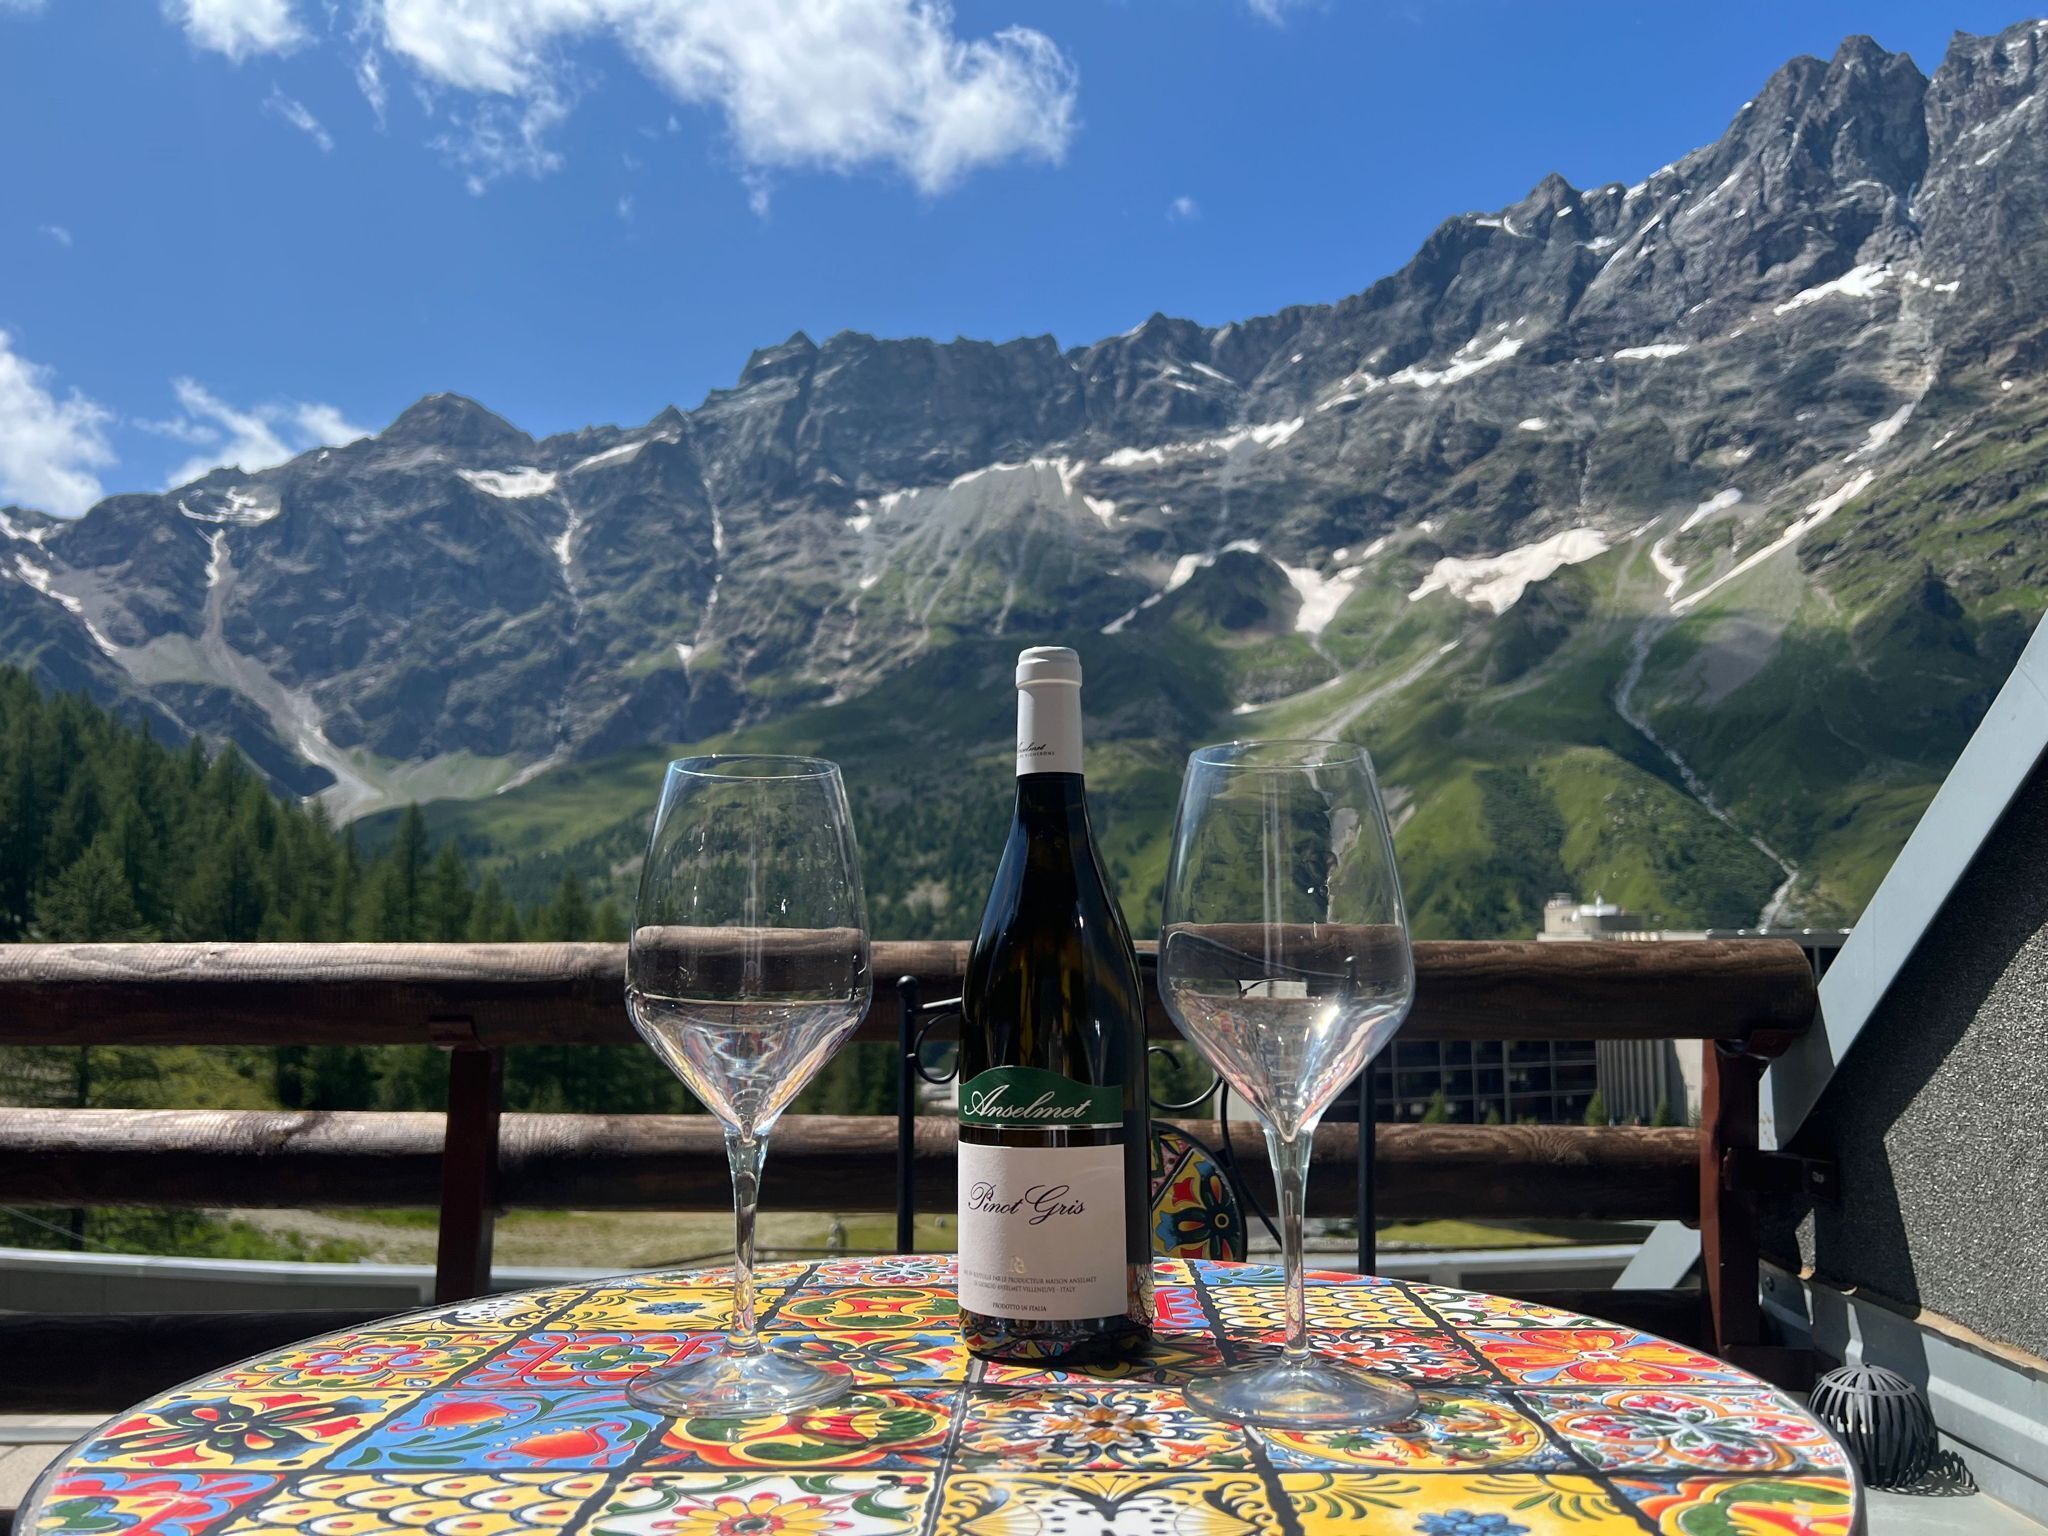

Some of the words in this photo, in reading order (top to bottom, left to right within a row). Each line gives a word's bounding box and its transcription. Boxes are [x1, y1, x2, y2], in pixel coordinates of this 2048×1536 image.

[964, 1084, 1092, 1119] Anselmet
[968, 1181, 1024, 1215] Pinot
[1024, 1184, 1085, 1226] Gris
[993, 1302, 1020, 1311] PRODOTTO
[1028, 1304, 1047, 1312] ITALIA
